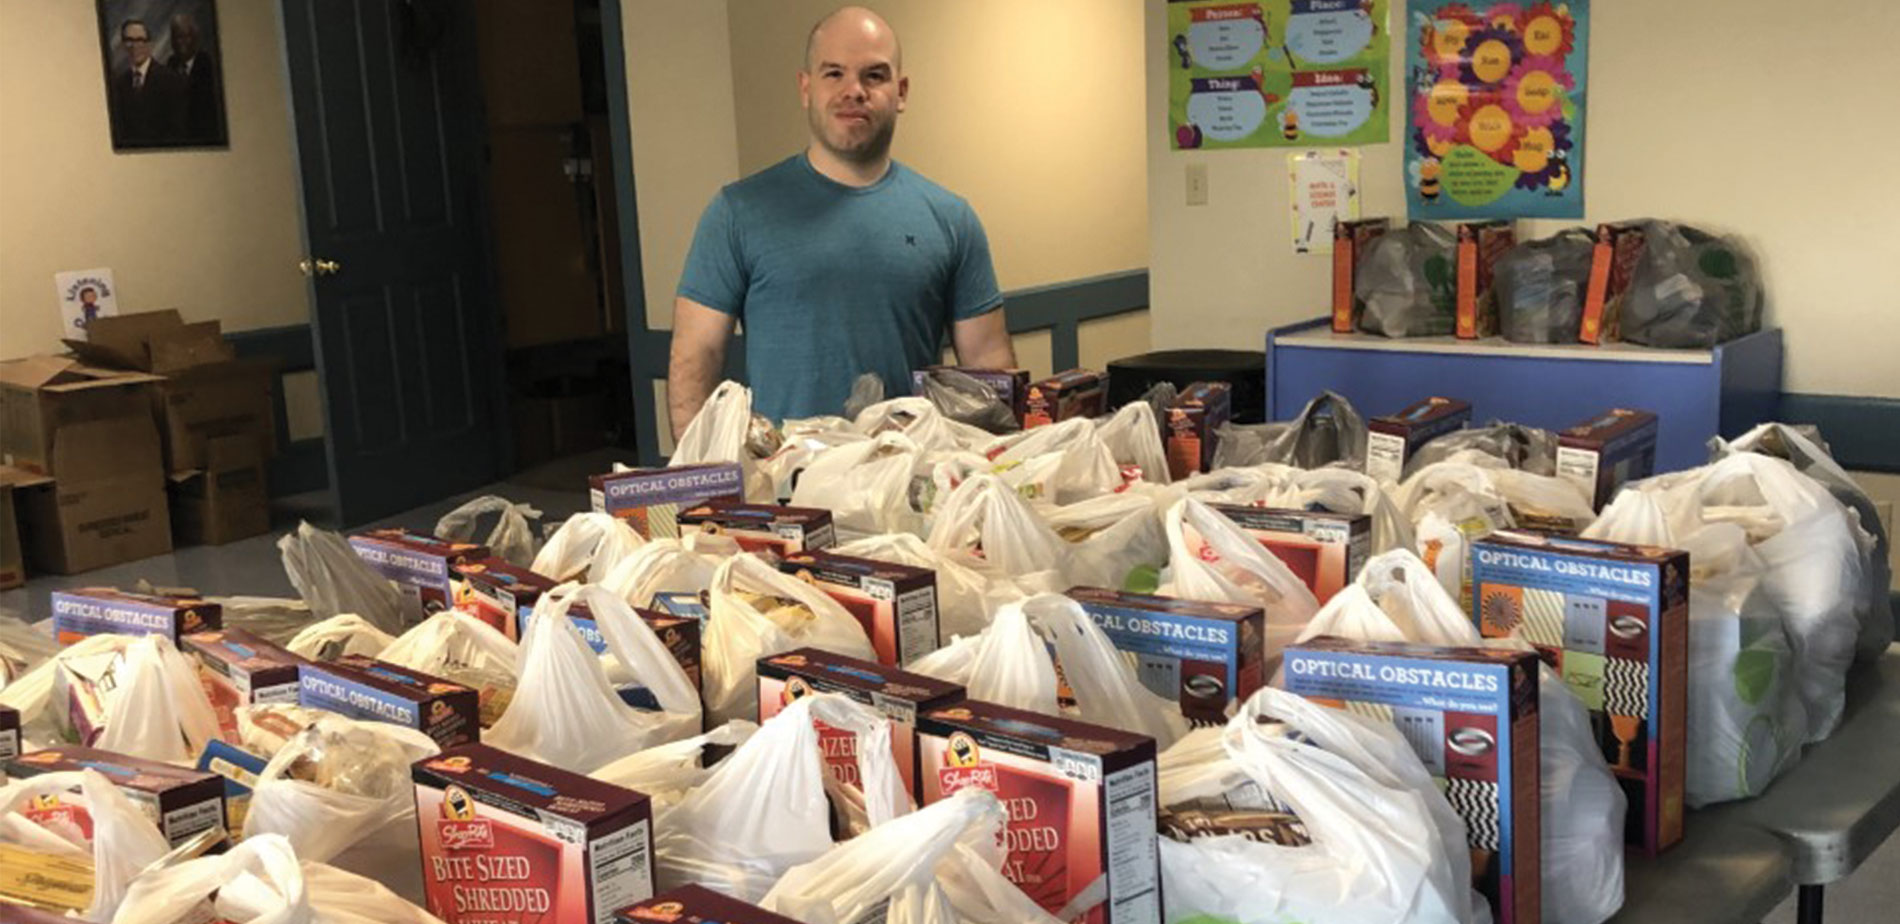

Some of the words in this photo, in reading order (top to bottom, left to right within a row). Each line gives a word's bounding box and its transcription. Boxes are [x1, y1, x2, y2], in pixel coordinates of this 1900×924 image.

[66, 277, 111, 301] Listening
[610, 477, 666, 496] OPTICAL
[668, 470, 739, 490] OBSTACLES
[390, 553, 442, 574] OBSTACLES
[1479, 551, 1551, 571] OPTICAL
[1555, 560, 1651, 586] OBSTACLES
[57, 600, 102, 619] OPTICAL
[104, 609, 169, 629] OBSTACLES
[1128, 618, 1228, 644] OBSTACLES
[1291, 658, 1375, 680] OPTICAL
[1380, 665, 1498, 692] OBSTACLES
[302, 674, 347, 701] OPTICAL
[350, 690, 413, 725] OBSTACLES
[442, 823, 488, 849] ShopRite
[1007, 827, 1059, 852] DDED
[431, 855, 474, 881] BITE
[476, 854, 530, 882] SIZED
[453, 885, 550, 913] SHREDDED
